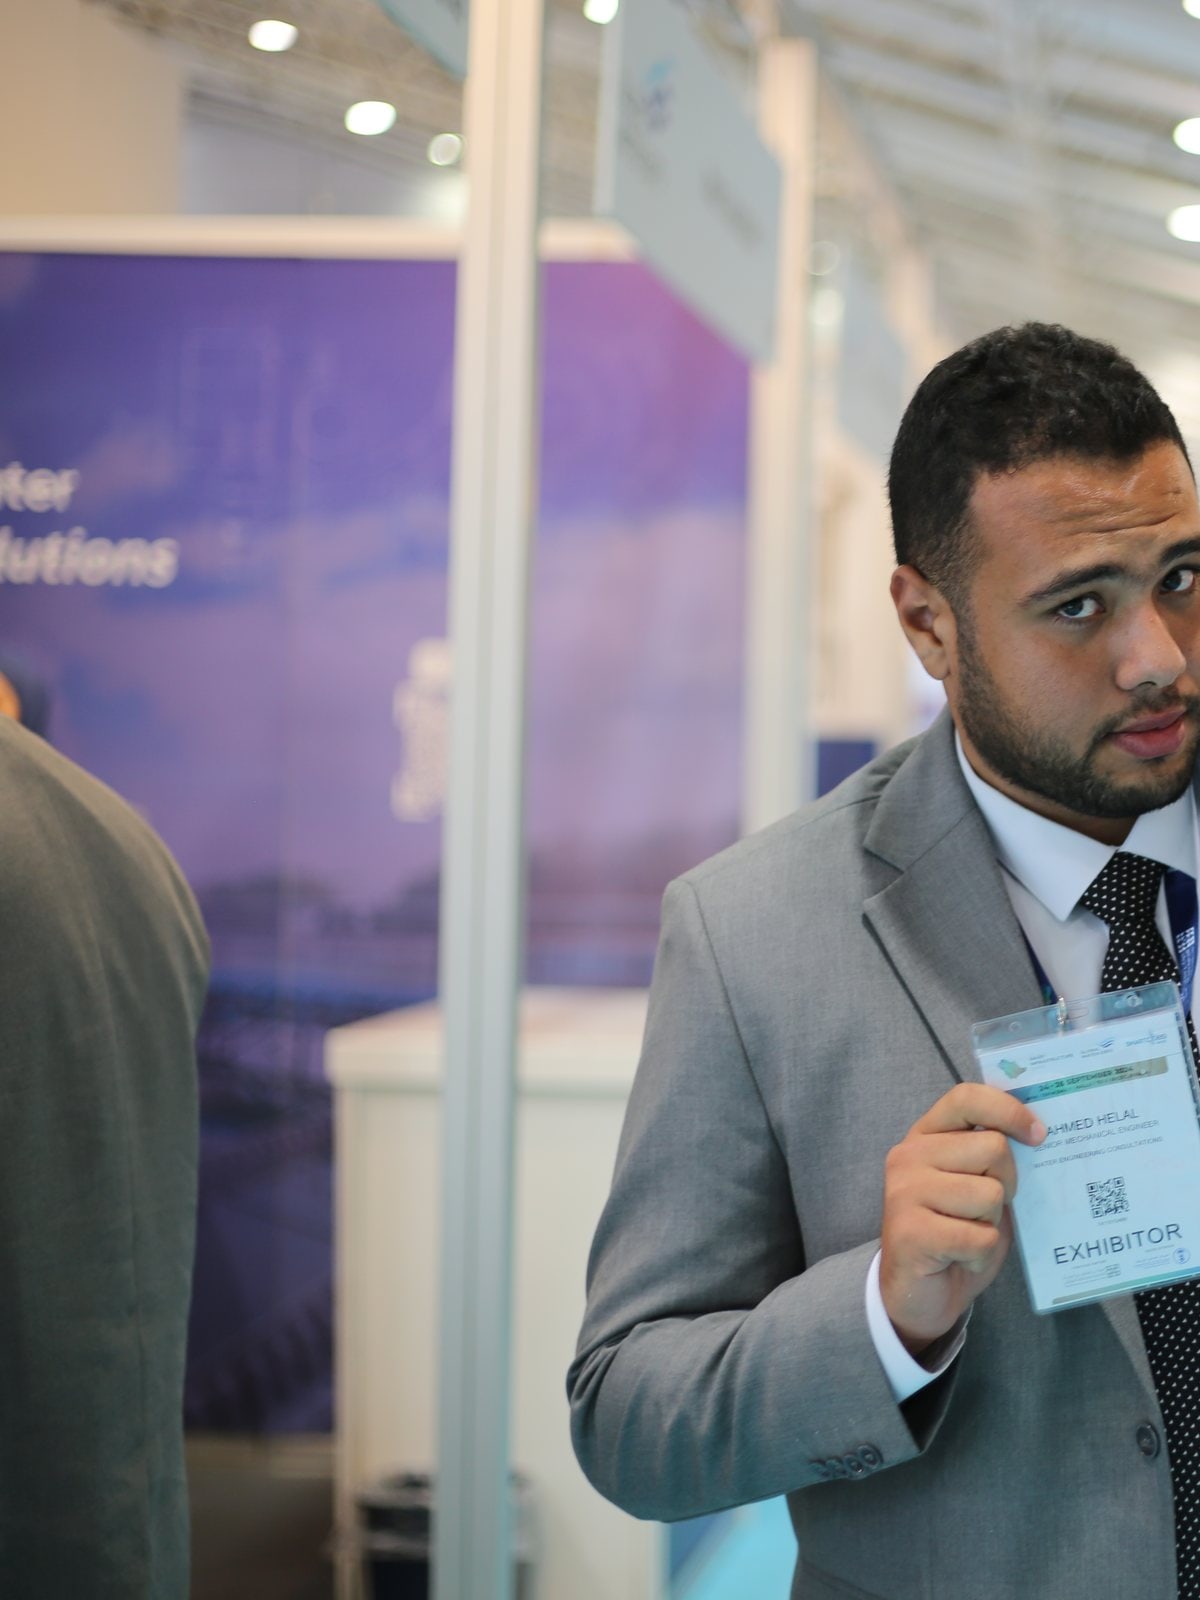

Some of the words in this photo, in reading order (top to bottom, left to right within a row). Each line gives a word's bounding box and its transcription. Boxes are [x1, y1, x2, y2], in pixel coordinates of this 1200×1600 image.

[0, 461, 80, 512] ter
[1047, 1117, 1094, 1136] AHMED
[1096, 1108, 1140, 1126] HELAL
[1065, 1129, 1116, 1145] MECHANICAL
[1118, 1119, 1160, 1134] ENGINEER
[1058, 1148, 1107, 1163] ENGINEERING
[1053, 1223, 1183, 1265] EXHIBITOR
